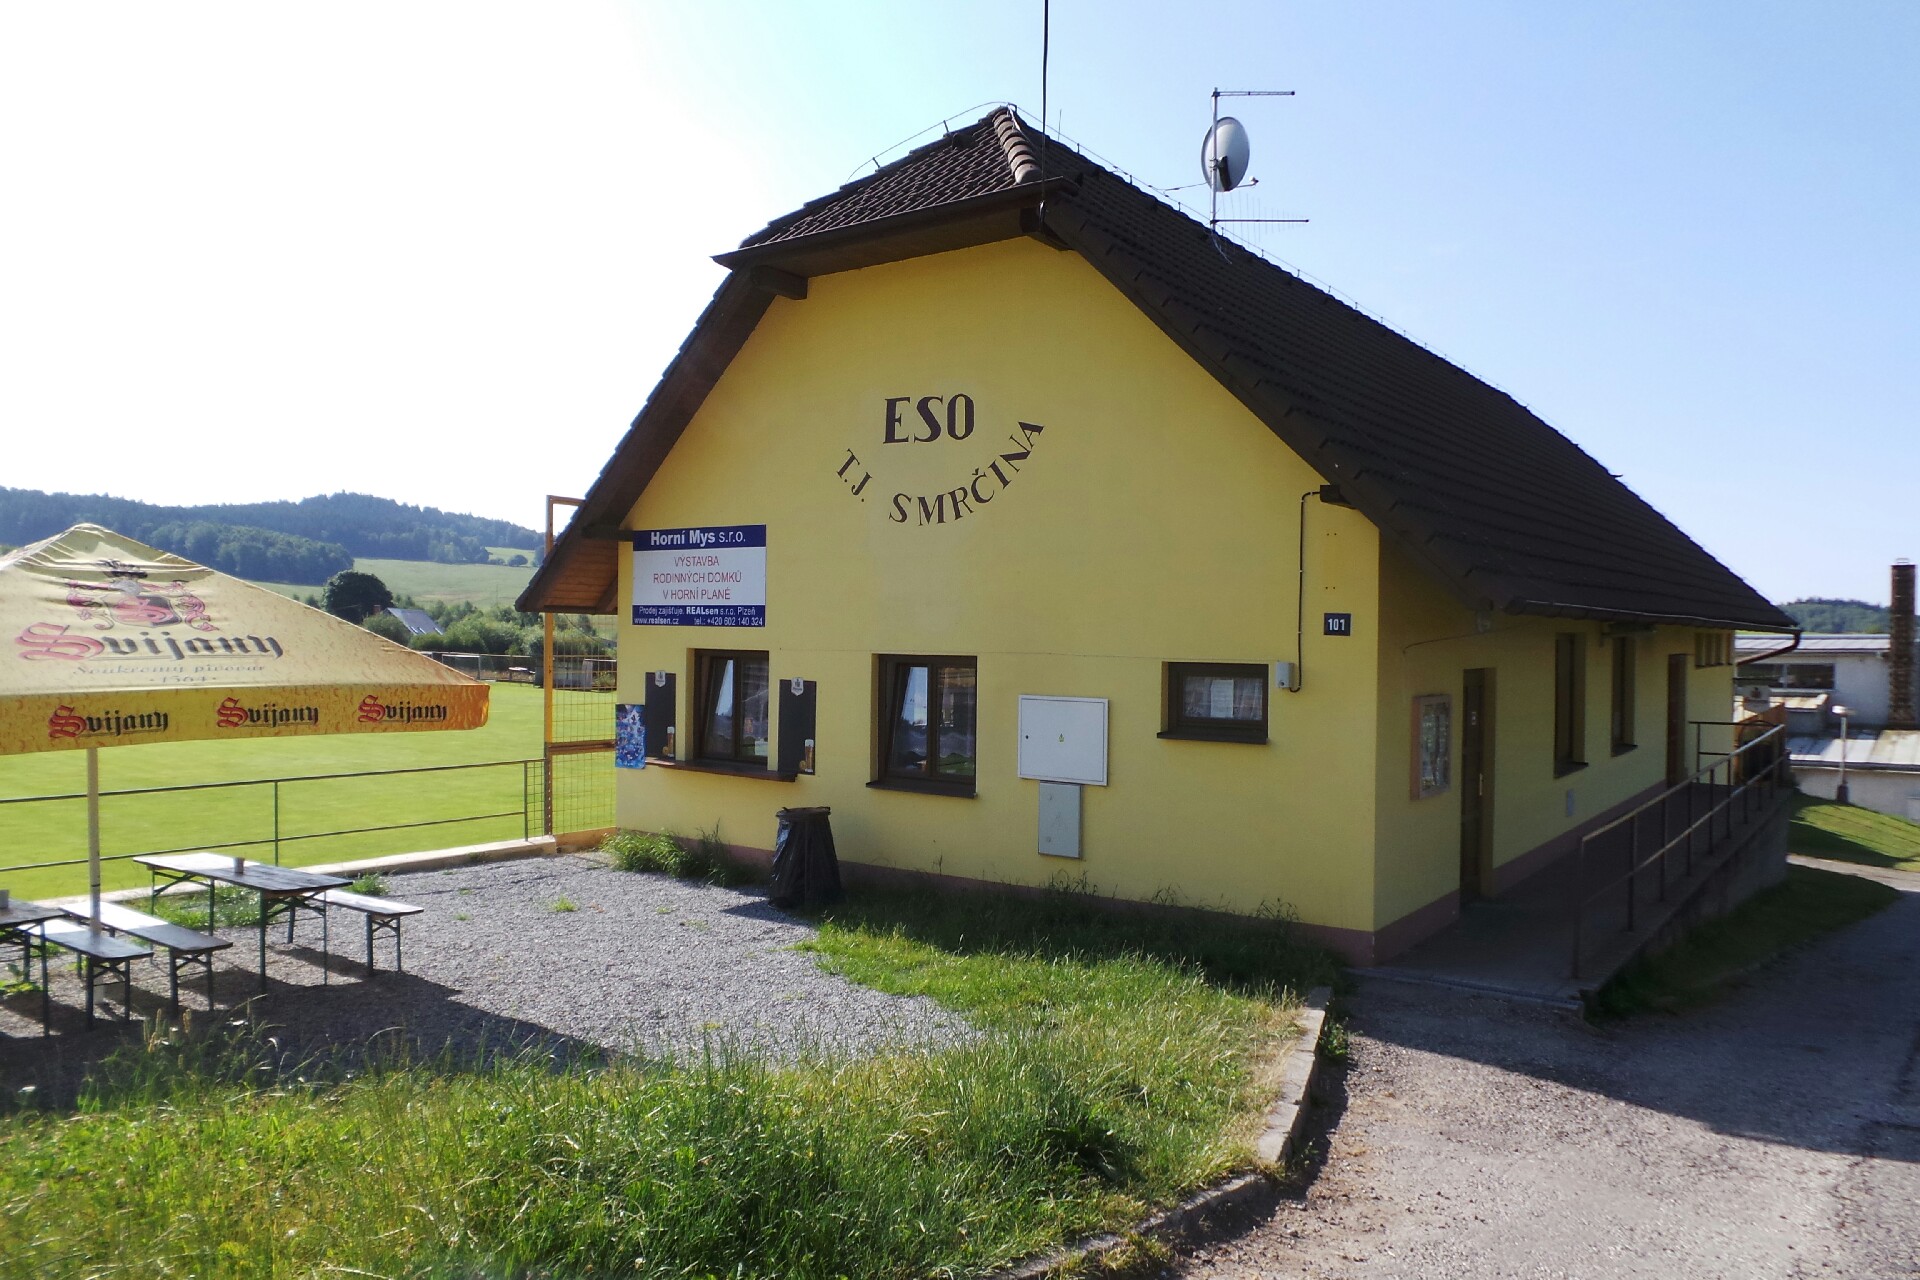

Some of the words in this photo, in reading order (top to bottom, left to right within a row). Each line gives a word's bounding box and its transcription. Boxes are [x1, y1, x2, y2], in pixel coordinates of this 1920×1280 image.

[883, 393, 975, 445] ESO
[837, 448, 873, 503] T.J.
[889, 421, 1045, 527] SMRČINA
[650, 531, 685, 546] Horní
[689, 530, 715, 547] Mys
[718, 531, 746, 543] s.r.o.
[674, 555, 720, 567] VÝSTAVBA
[653, 571, 705, 584] RODINNÝCH
[707, 570, 742, 583] DOMKŮ
[662, 590, 669, 600] V
[671, 587, 699, 600] HORNÍ
[701, 588, 731, 600] PLANÉ
[639, 606, 658, 617] Prodej
[686, 606, 719, 616] REALsen
[720, 607, 736, 616] s.r.o.
[737, 606, 756, 616] Plzeň
[634, 617, 680, 625] www.realsen.cz
[707, 617, 723, 626] +420
[723, 617, 736, 626] 602
[738, 617, 750, 626] 140
[751, 617, 763, 626] 324
[1328, 618, 1345, 631] 101
[15, 622, 284, 660] Svijany
[216, 697, 320, 728] Svijany
[357, 694, 448, 725] Svijany
[48, 705, 169, 739] Svijany
